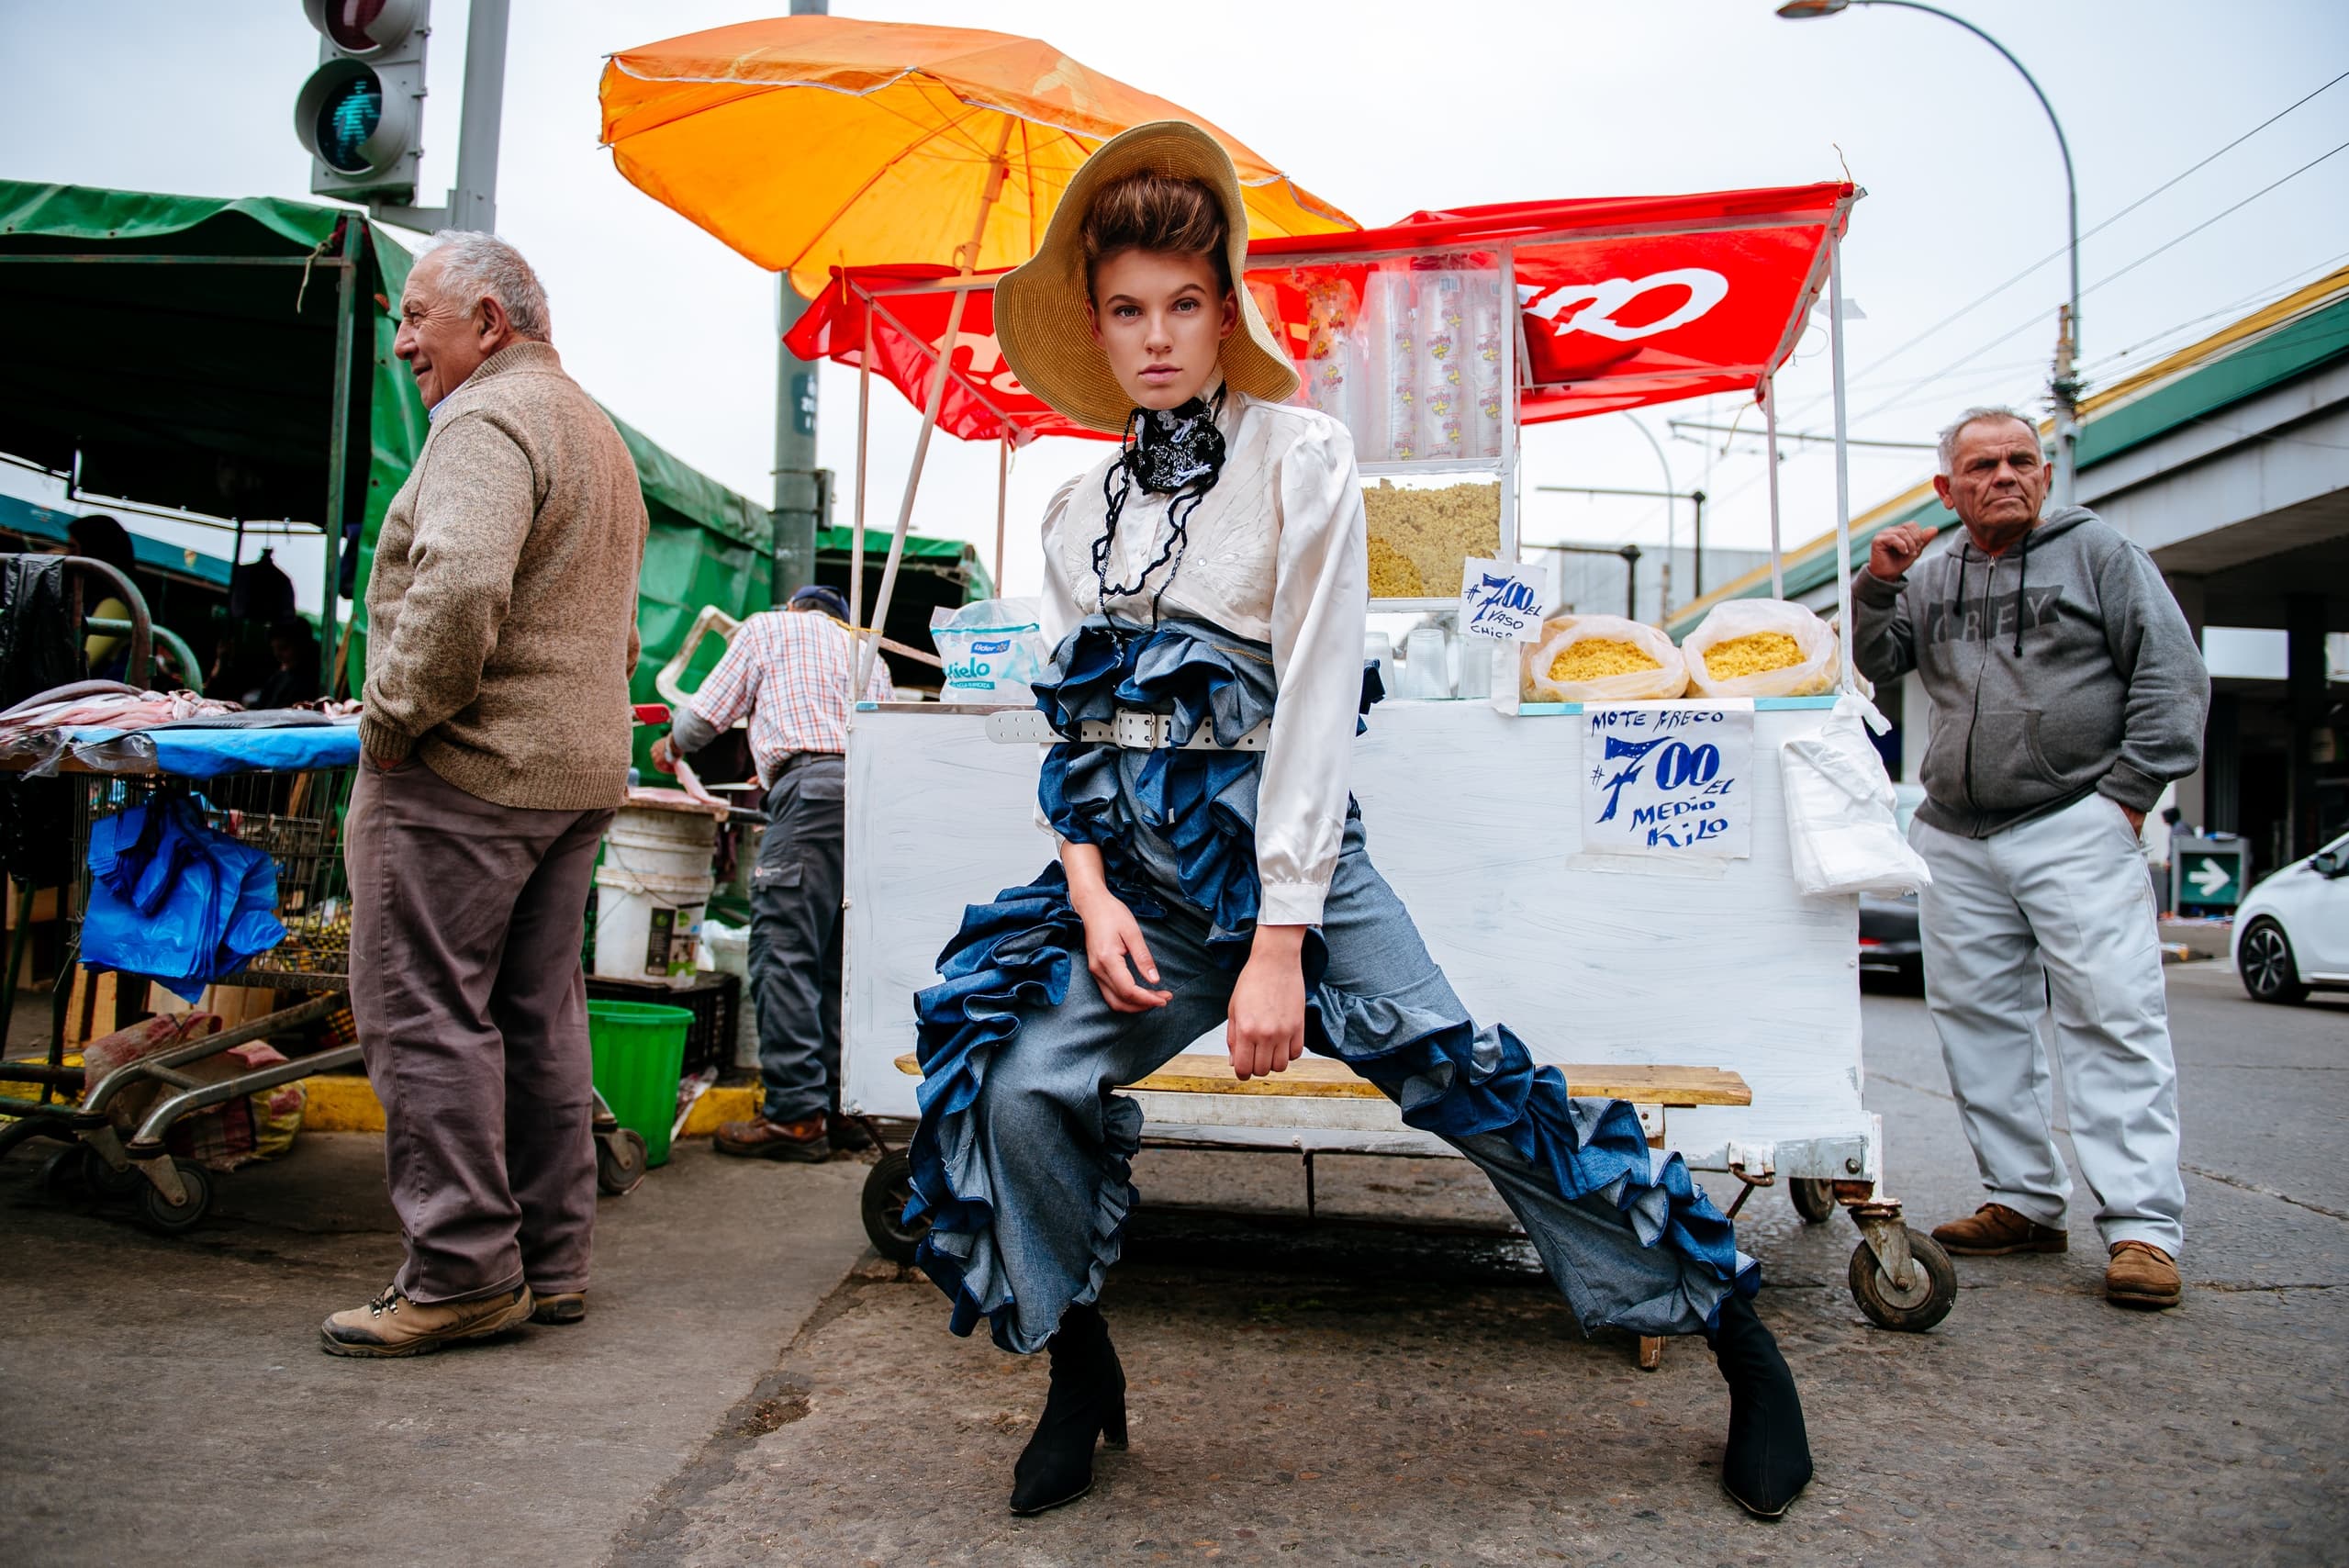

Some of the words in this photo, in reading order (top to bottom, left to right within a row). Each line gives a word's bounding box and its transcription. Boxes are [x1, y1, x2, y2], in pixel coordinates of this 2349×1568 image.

[1487, 610, 1524, 629] VASO
[1523, 605, 1542, 616] EL
[1592, 711, 1647, 737] MOTE
